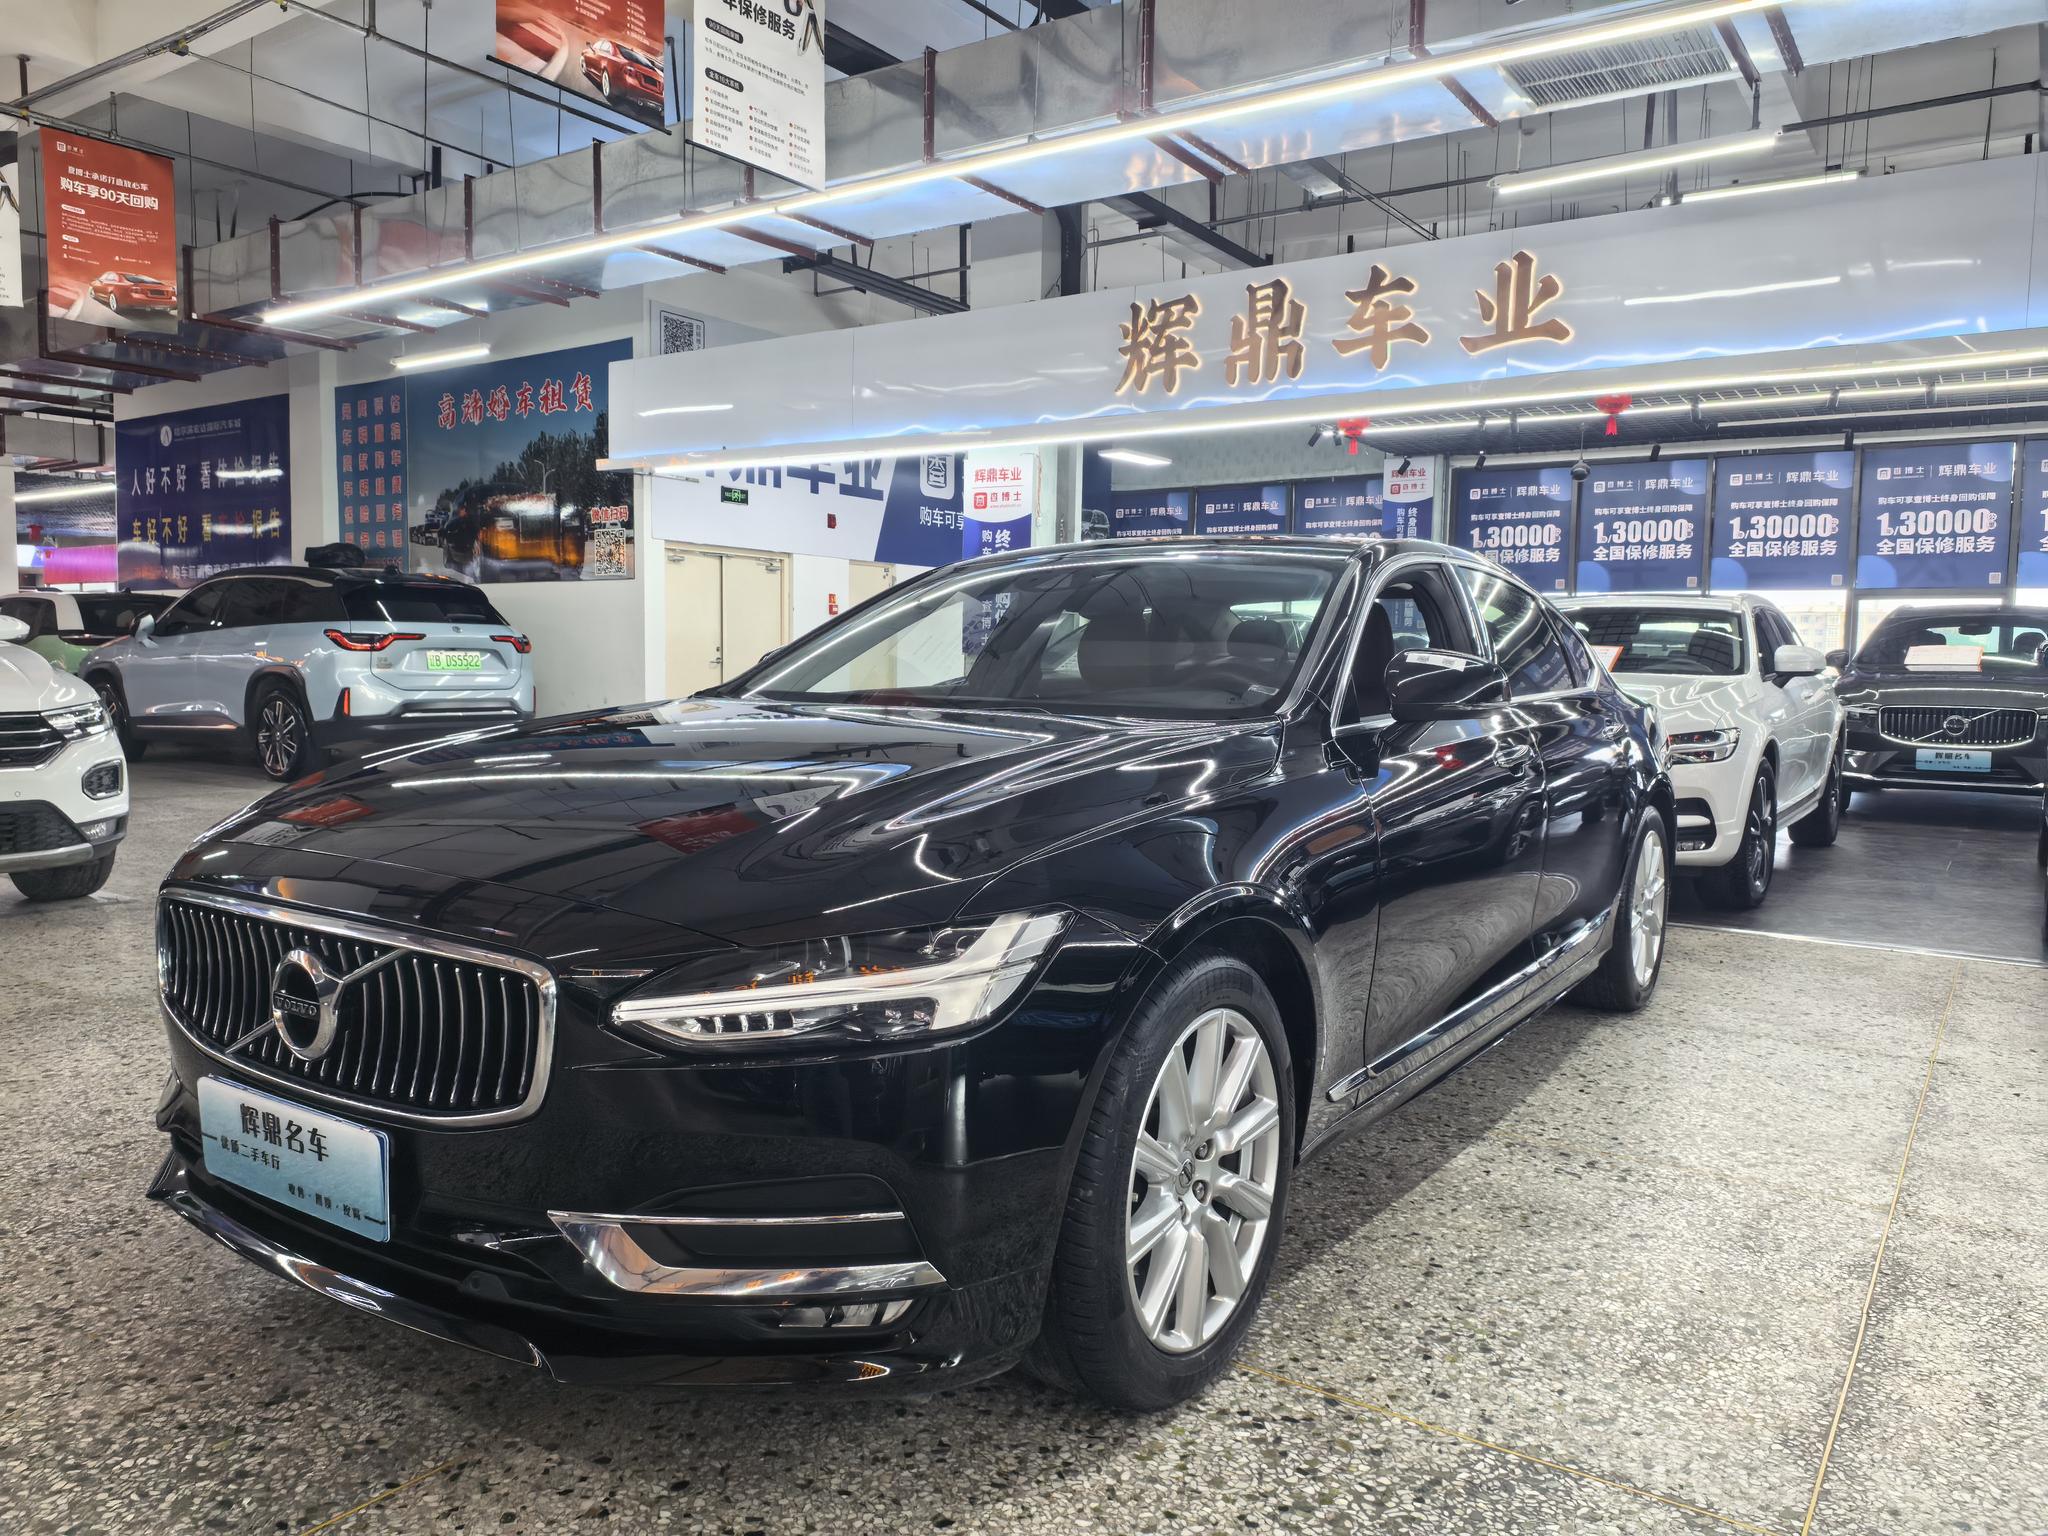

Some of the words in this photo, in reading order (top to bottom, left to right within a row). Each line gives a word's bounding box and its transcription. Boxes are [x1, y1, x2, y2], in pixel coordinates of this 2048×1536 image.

[60, 176, 159, 210] 购车享90天回购
[1115, 250, 1573, 394] 辉鼎车业
[438, 371, 595, 430] 高端婚车租赁
[974, 467, 1022, 483] 辉鼎车业
[1786, 470, 1839, 483] 辉鼎车业
[1938, 462, 1997, 477] 辉鼎车业
[131, 464, 187, 496] 人好不好
[1517, 483, 1560, 496] 辉鼎车业
[1645, 477, 1693, 489] 辉鼎车业
[1408, 507, 1417, 539] 终身回
[1593, 543, 1693, 561] 全国保修服务
[1728, 540, 1838, 558] 全国保修服务
[1877, 536, 1996, 555] 全国保修服务
[274, 996, 317, 1016] VOLVO
[240, 1103, 329, 1162] 辉鼎名车
